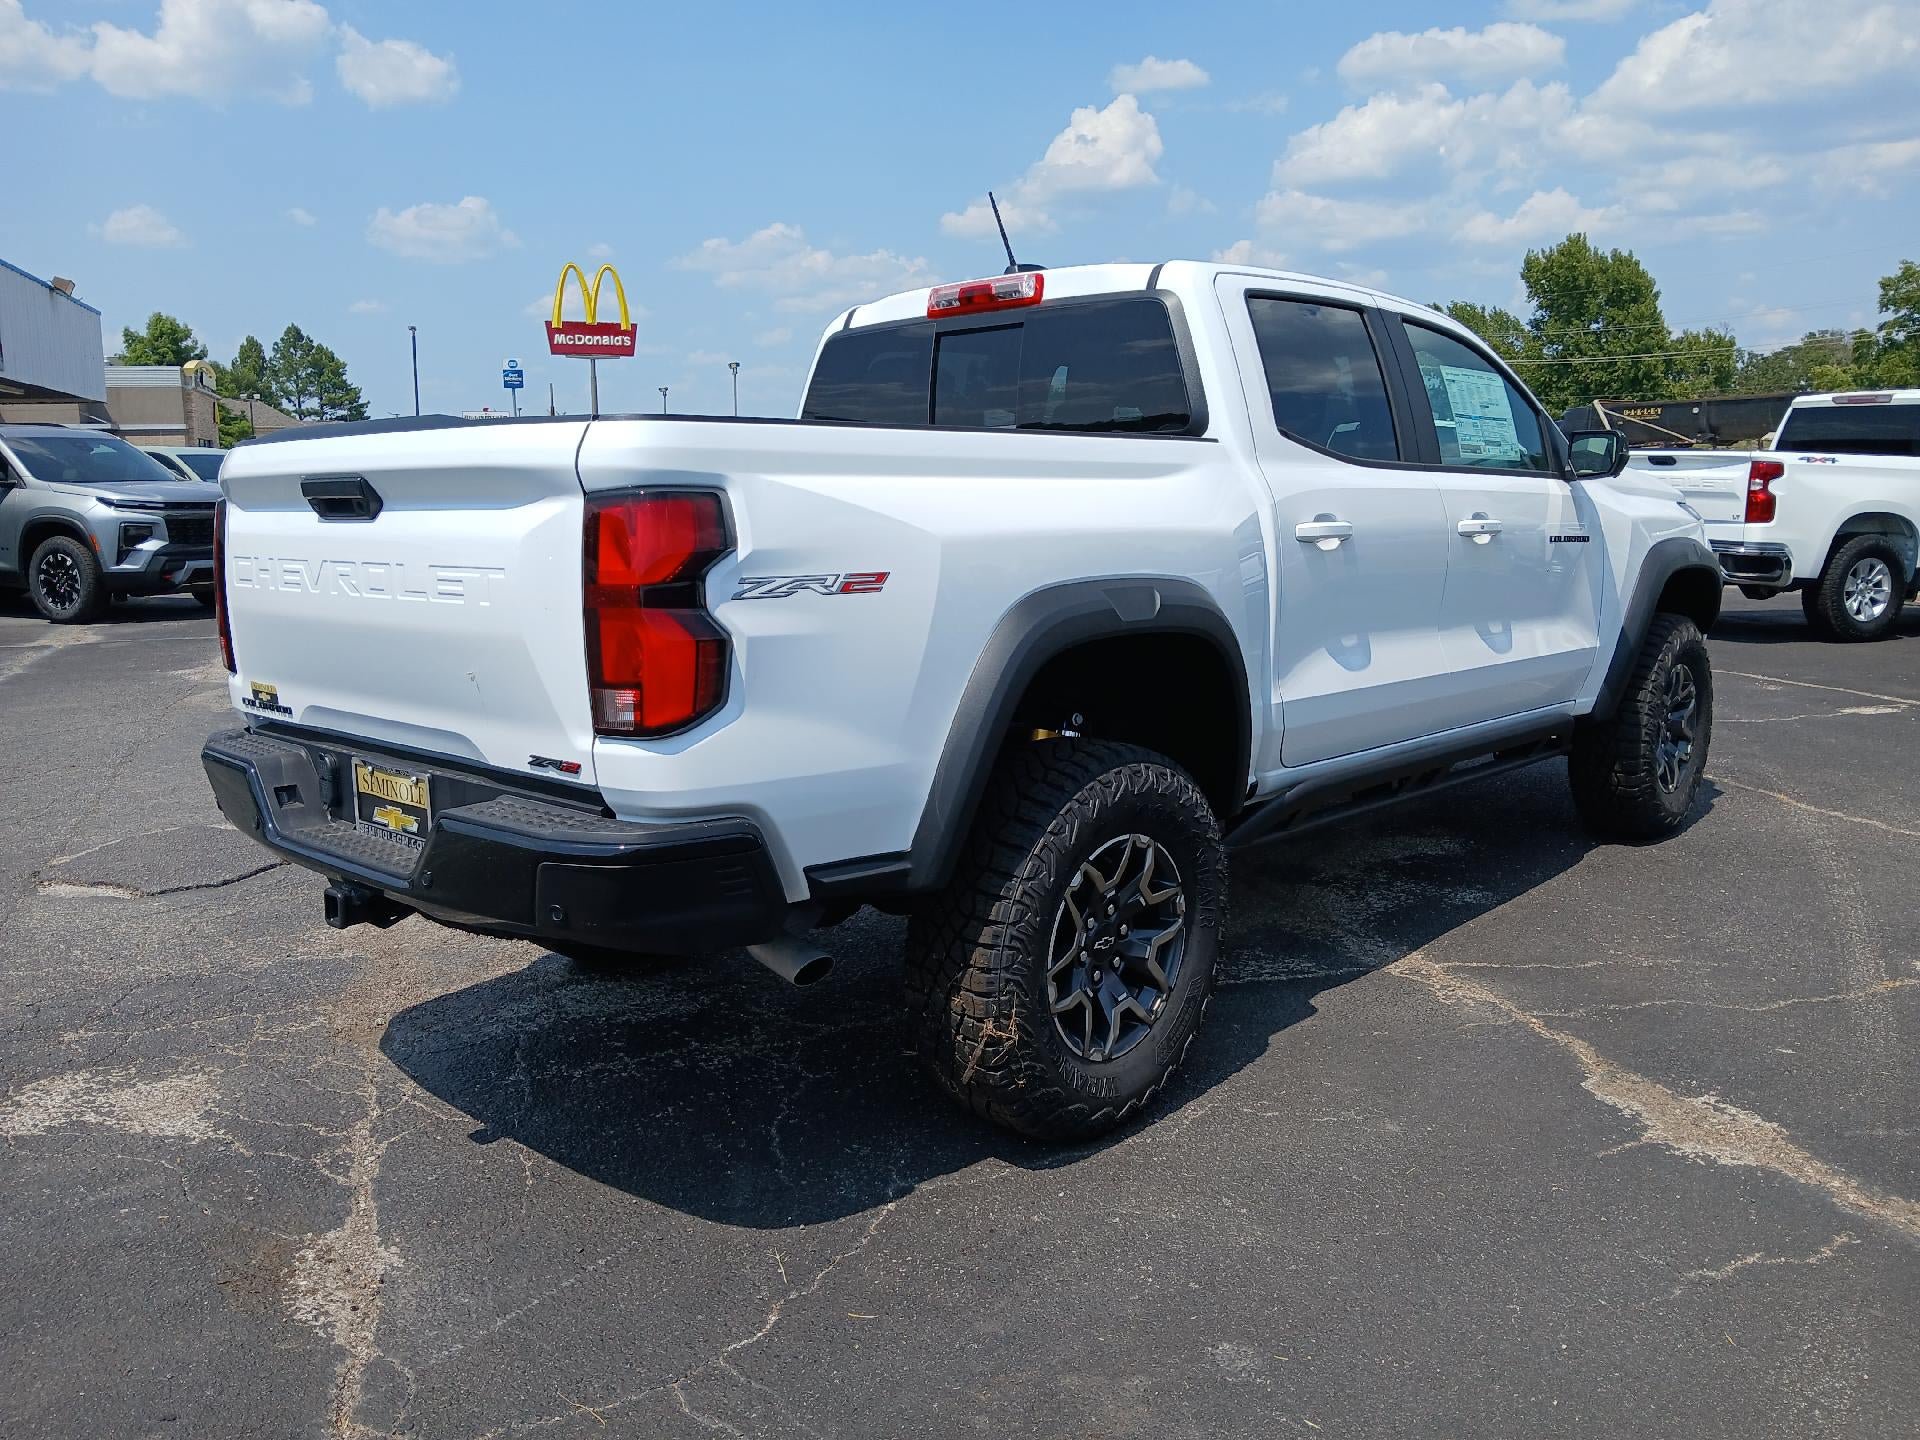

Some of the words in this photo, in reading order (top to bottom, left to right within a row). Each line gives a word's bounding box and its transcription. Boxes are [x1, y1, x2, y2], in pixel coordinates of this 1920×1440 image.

[553, 334, 632, 346] McDonald's
[233, 555, 505, 606] CHEVROLET
[731, 571, 891, 600] ZR2
[527, 754, 582, 775] ZR2
[362, 773, 426, 806] SEMINOLE
[360, 823, 425, 850] SEMINOLEGM.CO
